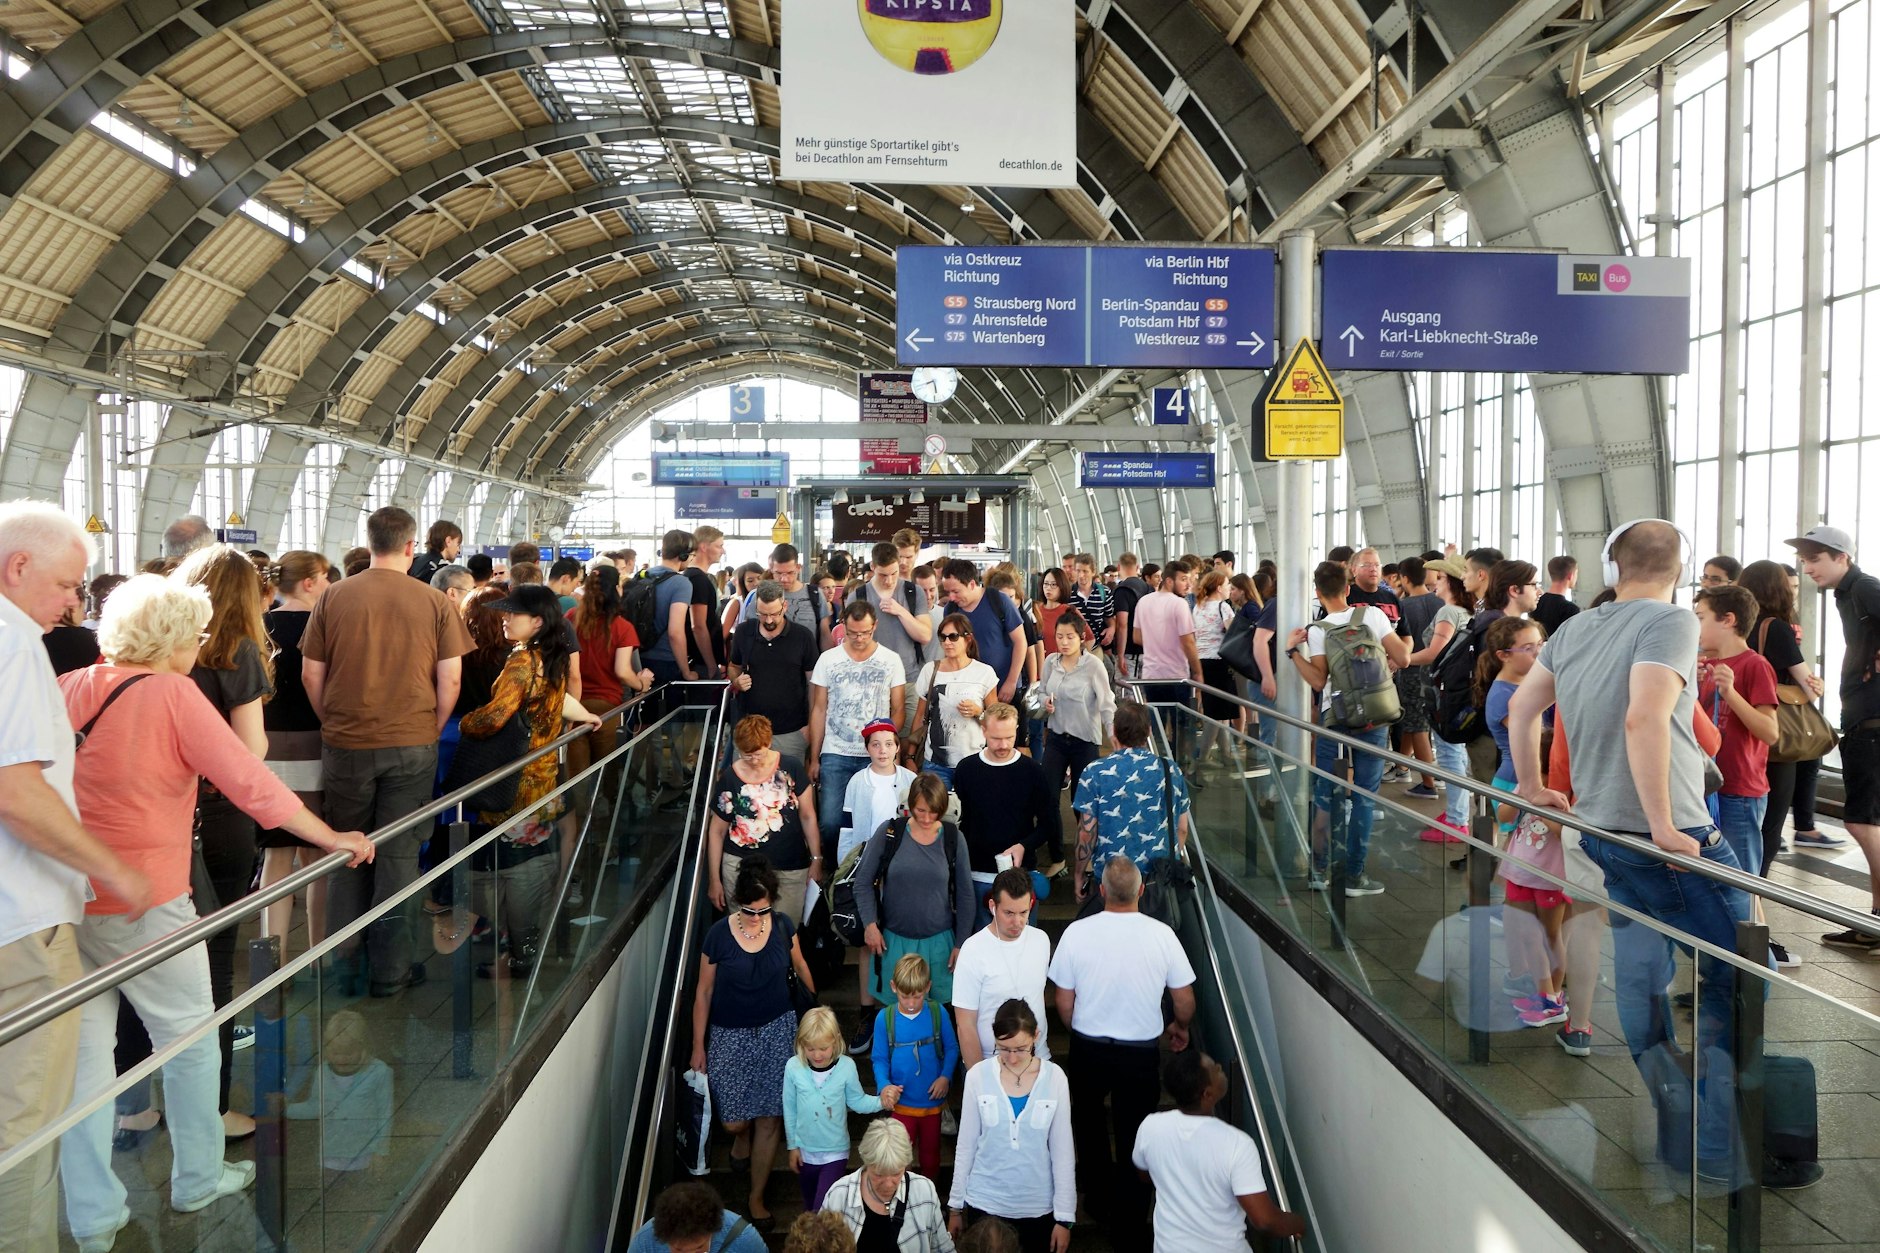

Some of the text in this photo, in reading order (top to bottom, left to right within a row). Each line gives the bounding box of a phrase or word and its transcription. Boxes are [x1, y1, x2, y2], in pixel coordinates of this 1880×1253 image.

[795, 136, 960, 154] Mehr günstige Sportartikel gibt's
[795, 151, 949, 167] bei Decathlon am Fernsehturm
[999, 158, 1063, 171] decathlon.de
[944, 253, 1022, 267] via Ostkreuz
[1145, 255, 1230, 269] via Berlin Hbf
[944, 269, 1001, 286] Richtung
[1172, 273, 1229, 288] Richtung
[1576, 272, 1598, 283] TAXI
[1609, 273, 1627, 283] Bus
[947, 296, 1077, 312] S5 Strausberg Nord
[1101, 298, 1224, 313] Berlin-Spandau S5
[947, 313, 1048, 327] S7 Ahrensfelde
[1119, 315, 1224, 328] Potsdam Hbf S7
[1380, 308, 1441, 326] Ausgang
[946, 331, 1046, 346] S75 Wartenberg
[1134, 332, 1225, 346] Westkreuz S75
[1379, 328, 1539, 345] Karl-Liebknecht-Straße
[1380, 349, 1396, 358] Exit
[1401, 349, 1424, 359] Sortie
[733, 387, 752, 414] 3
[1166, 389, 1185, 416] 4
[1122, 461, 1153, 470] Spandau
[1088, 469, 1167, 478] S7 Potsdam Hbf
[834, 671, 885, 685] GARAGE
